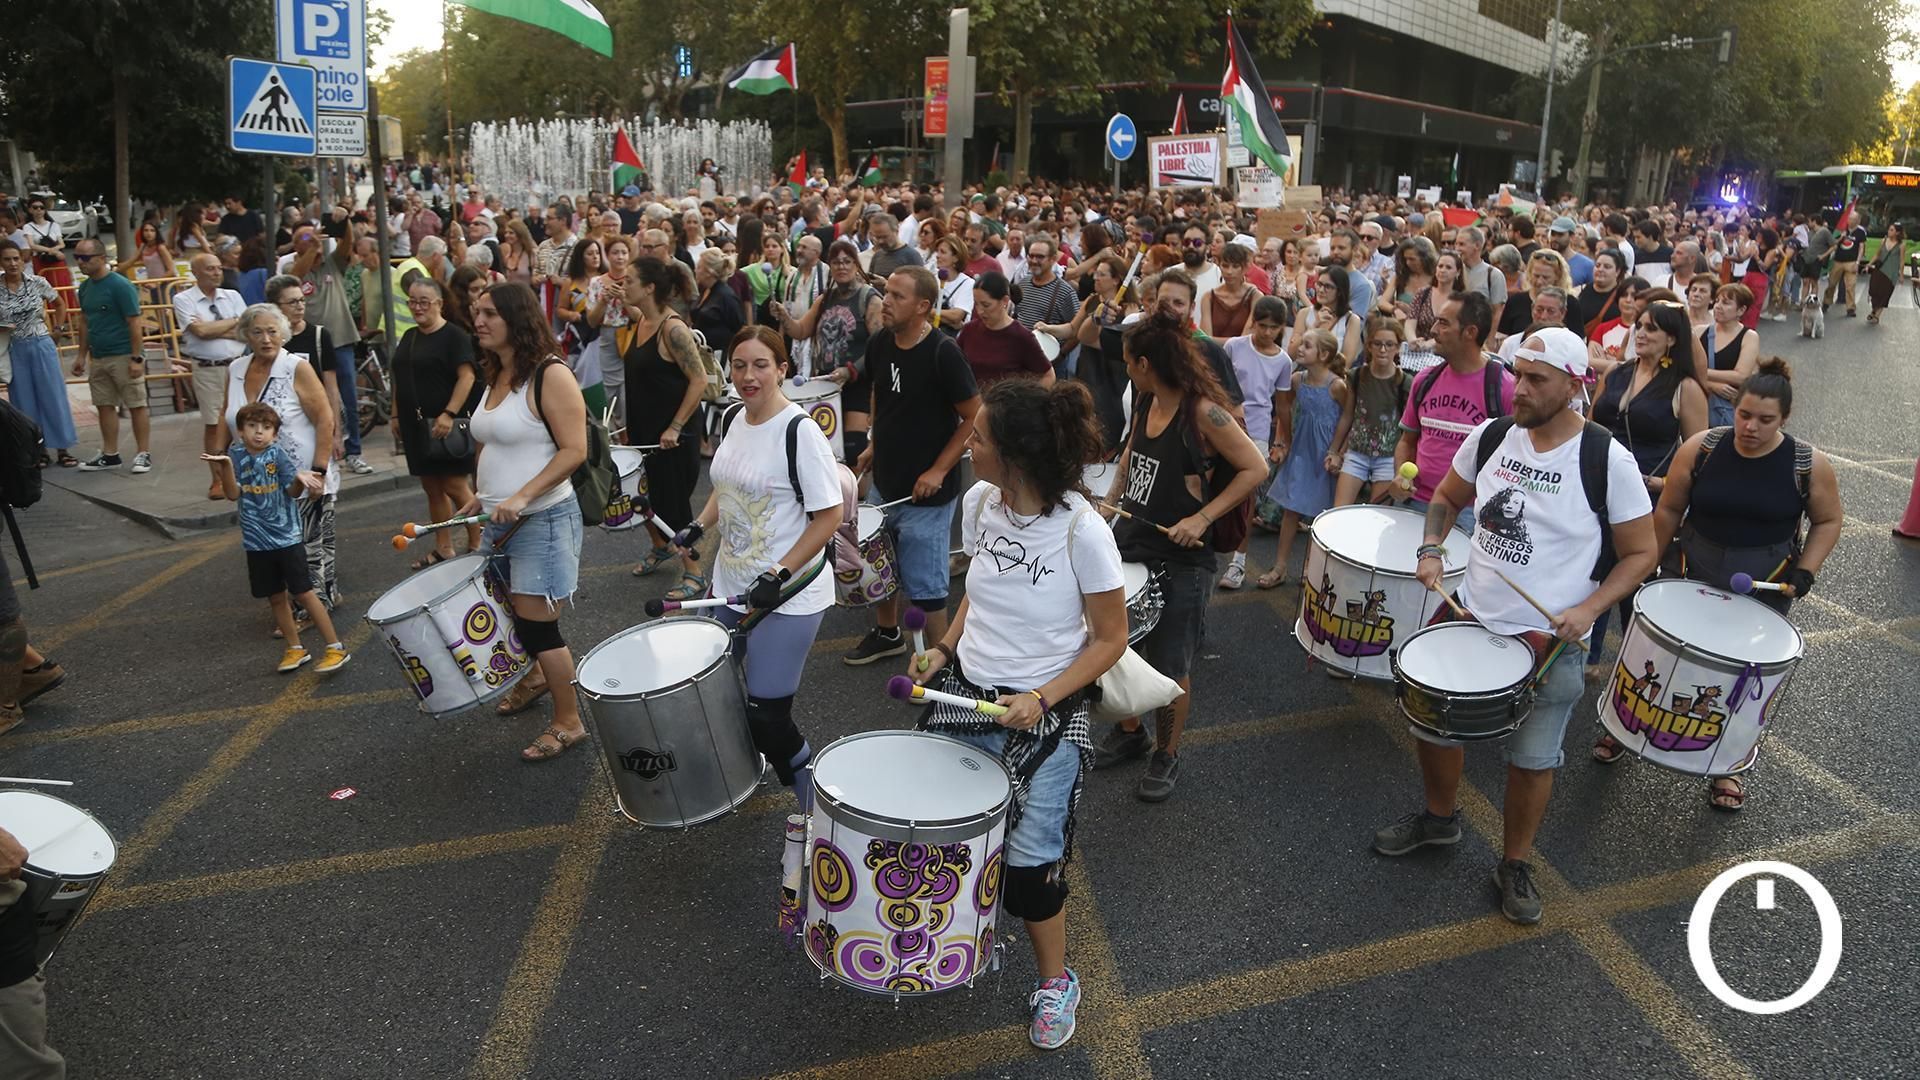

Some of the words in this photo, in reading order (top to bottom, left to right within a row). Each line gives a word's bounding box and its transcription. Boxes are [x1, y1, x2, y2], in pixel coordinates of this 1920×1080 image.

[303, 3, 340, 51] P
[317, 65, 358, 85] mino
[1199, 98, 1225, 115] caj
[319, 127, 354, 135] ORABLES
[1158, 141, 1211, 157] PALESTINA
[1158, 158, 1186, 172] LIBRE
[1421, 394, 1486, 425] TRIDENTE
[1500, 456, 1562, 484] LIBERTAD
[1489, 533, 1534, 554] PRESOS
